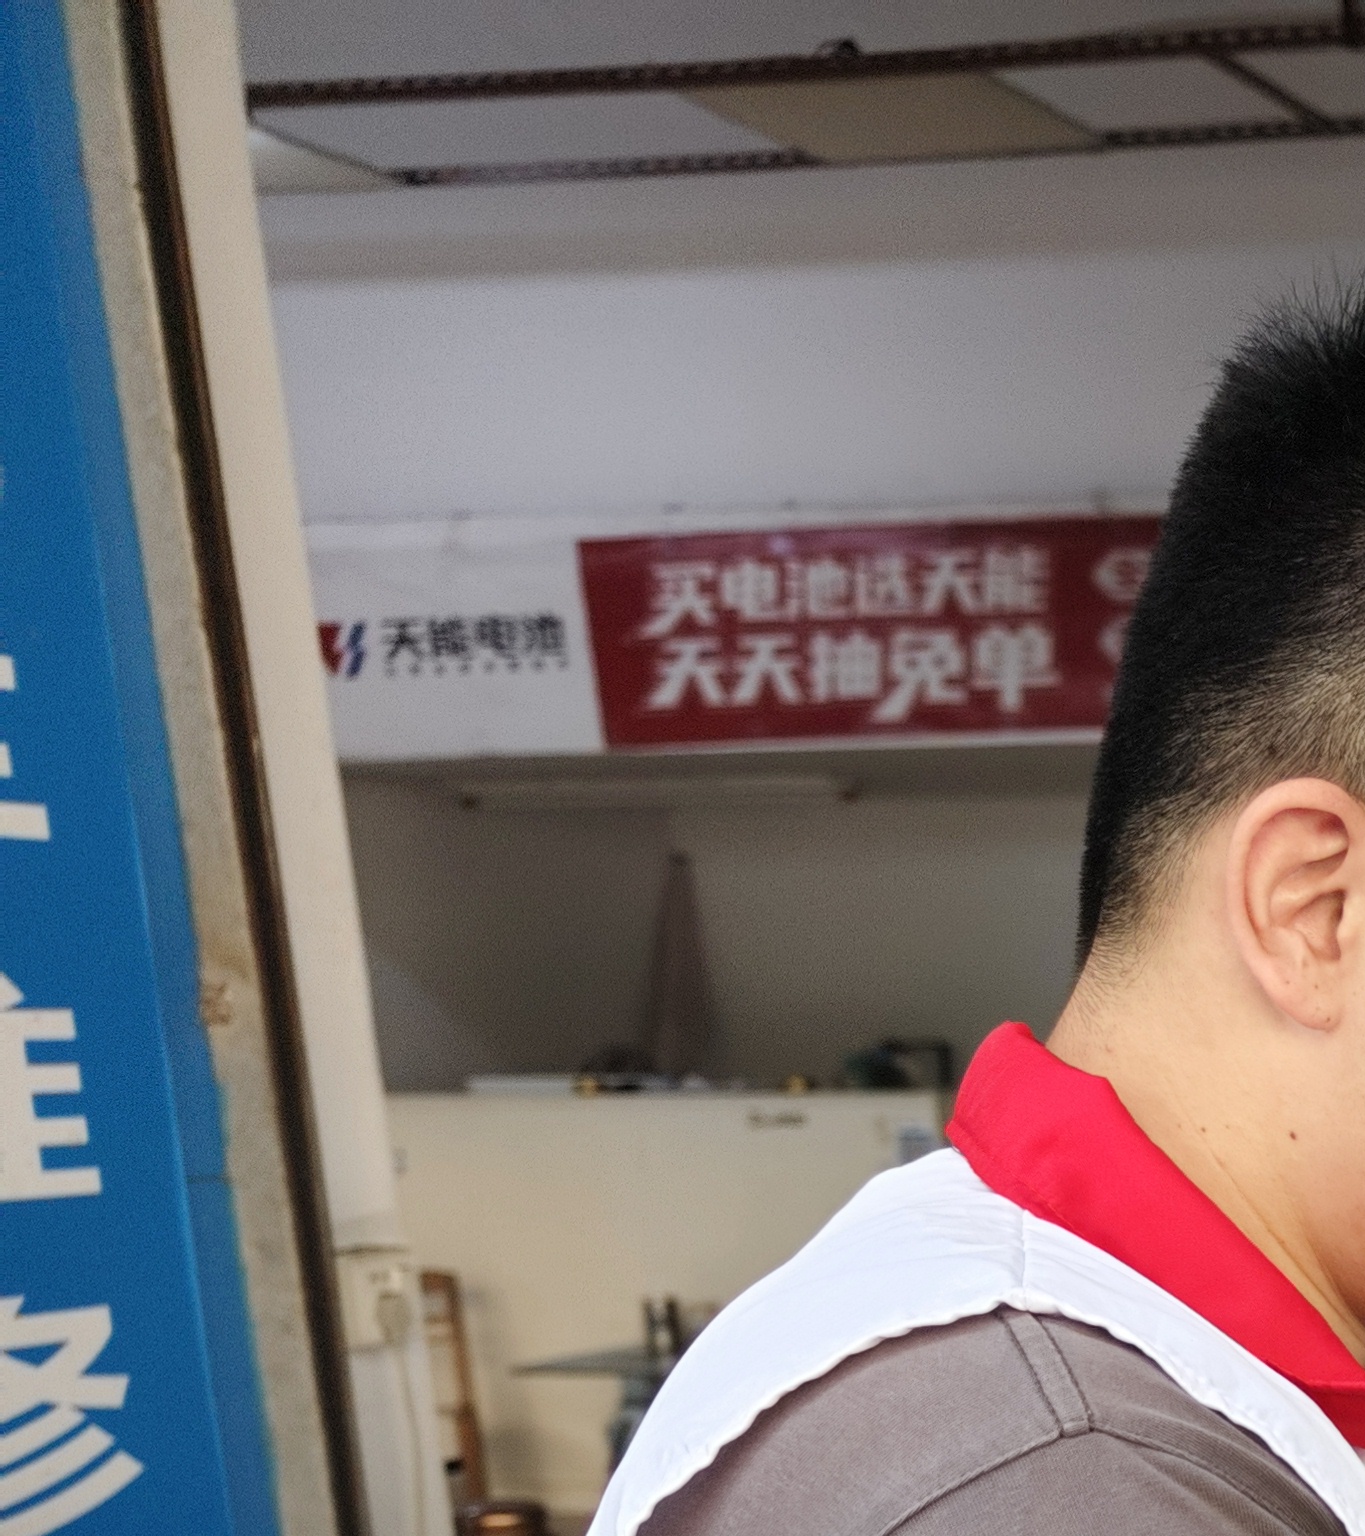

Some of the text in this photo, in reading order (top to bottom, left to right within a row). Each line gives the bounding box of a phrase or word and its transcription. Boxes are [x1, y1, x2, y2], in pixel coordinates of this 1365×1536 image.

[382, 613, 565, 659] 天能电池
[647, 624, 1058, 721] 天天抽免单
